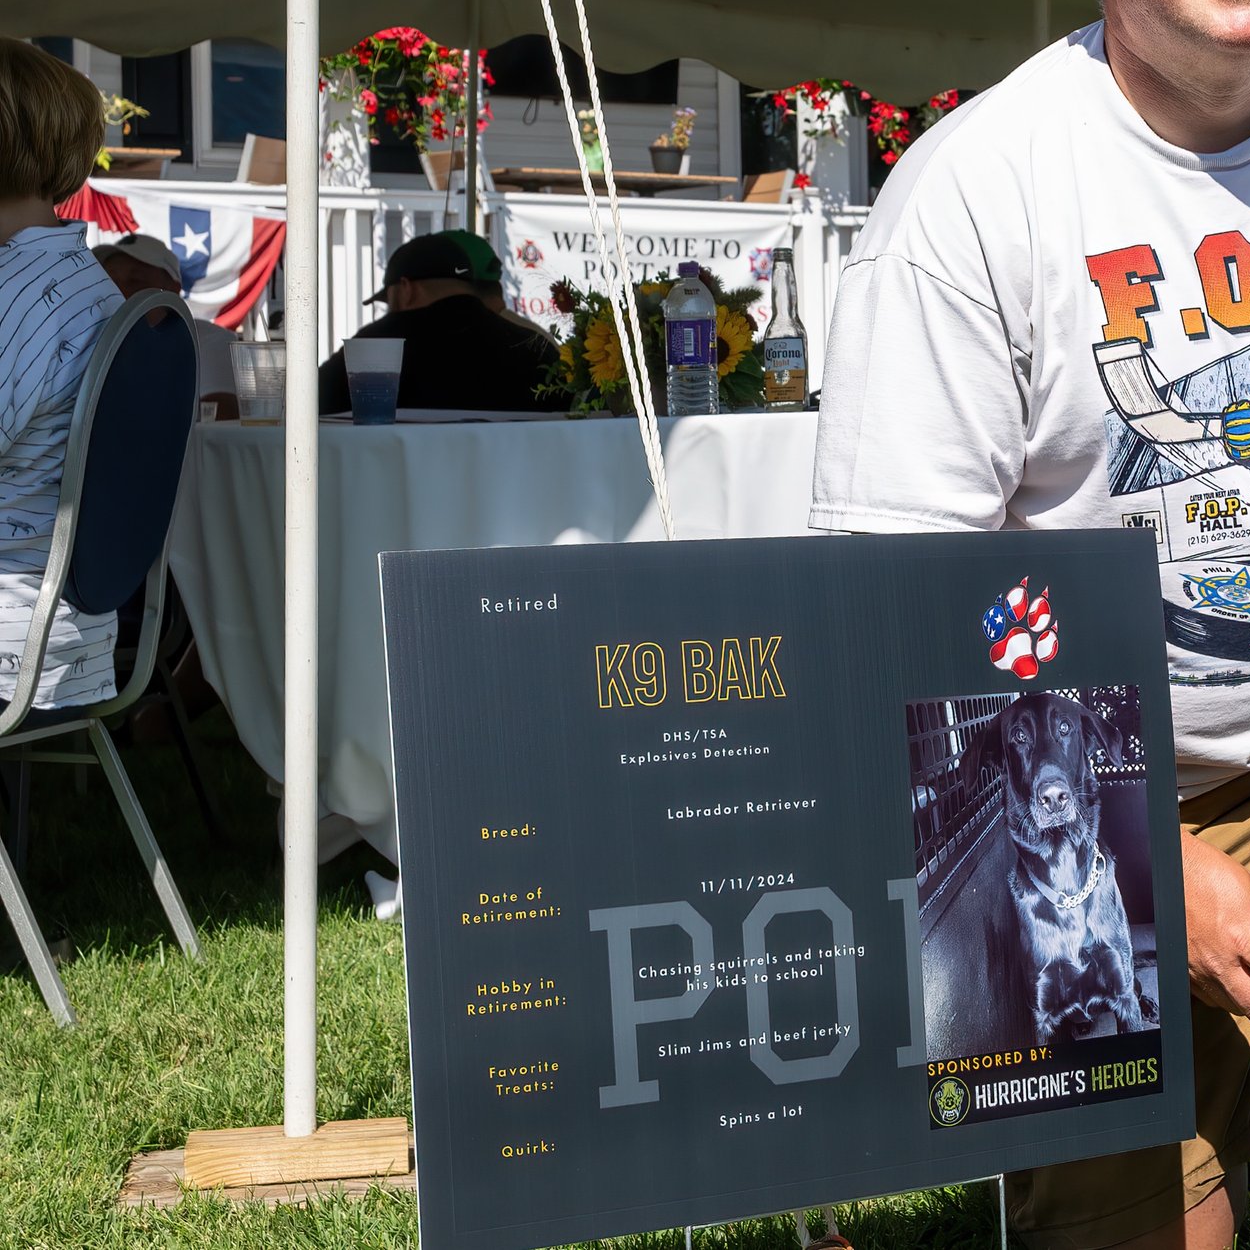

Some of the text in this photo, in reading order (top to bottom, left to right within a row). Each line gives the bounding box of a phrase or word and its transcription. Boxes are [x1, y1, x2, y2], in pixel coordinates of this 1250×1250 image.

[705, 238, 741, 260] TO
[765, 349, 802, 362] Corona
[1189, 494, 1203, 502] CATER
[1203, 492, 1215, 500] YOUR
[1215, 490, 1227, 498] NEXT
[1185, 496, 1248, 524] F.O.P.
[1200, 518, 1243, 534] HALL
[1187, 535, 1209, 547] (215)
[1202, 566, 1236, 574] PHILA.
[481, 594, 559, 614] Retired
[595, 635, 787, 709] K9 BAK
[663, 728, 728, 743] DHS/TSA
[620, 745, 770, 766] Explosives Detection
[667, 797, 818, 820] Labrador Retriever
[481, 824, 538, 841] Breed:
[700, 872, 796, 894] 11/11/2024
[479, 887, 544, 906] Date of
[461, 905, 562, 925] Retirement:
[638, 942, 867, 980] Chasing squirrels and taking
[477, 976, 555, 999] Hobby in
[686, 965, 824, 993] his kids to school
[466, 995, 568, 1016] Retirement:
[658, 1022, 853, 1058] Slim Jims and beef jerky
[488, 1060, 560, 1079] Favorite
[927, 1047, 1053, 1077] SPONSORED BY:
[495, 1078, 555, 1097] Treats:
[974, 1057, 1159, 1110] HURRICANE'S HEROES
[719, 1103, 803, 1129] Spins a lot
[501, 1140, 557, 1158] Quirk:
